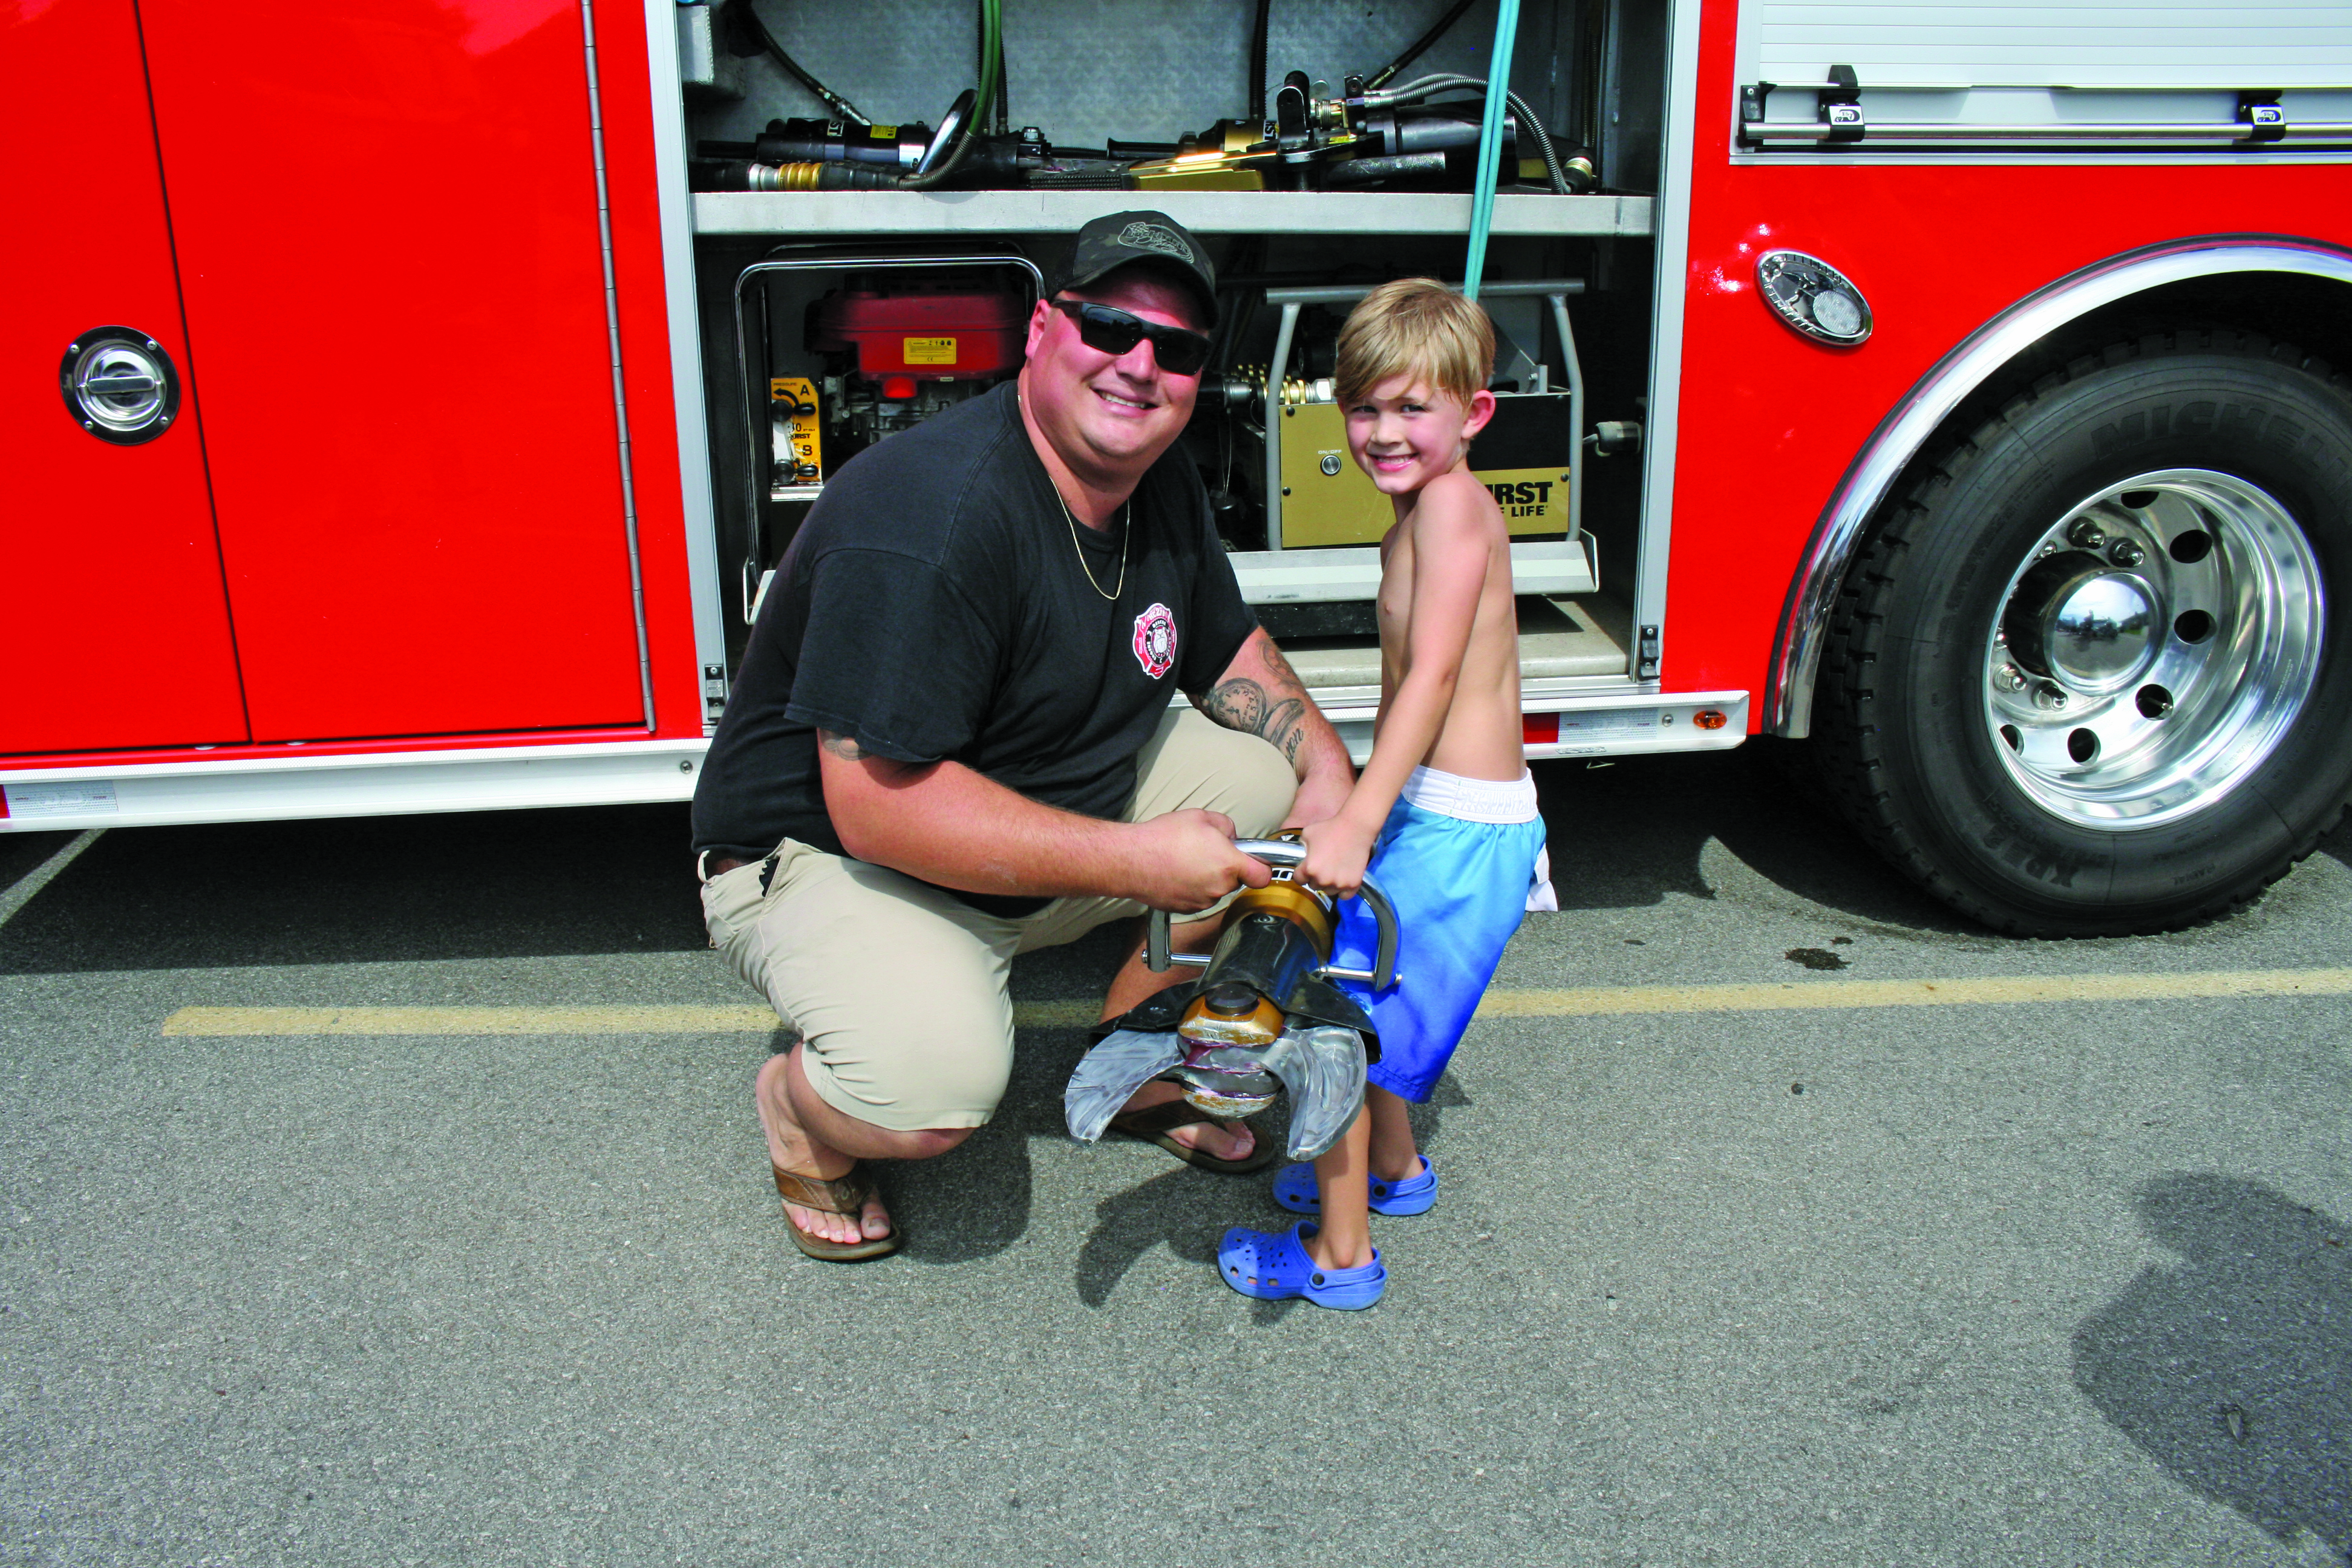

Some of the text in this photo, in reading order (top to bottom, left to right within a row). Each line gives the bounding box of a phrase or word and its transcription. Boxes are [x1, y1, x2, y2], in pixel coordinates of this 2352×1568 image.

[800, 384, 810, 396] A
[803, 445, 812, 456] B
[1485, 482, 1553, 505] RST
[1511, 505, 1544, 517] LIFE
